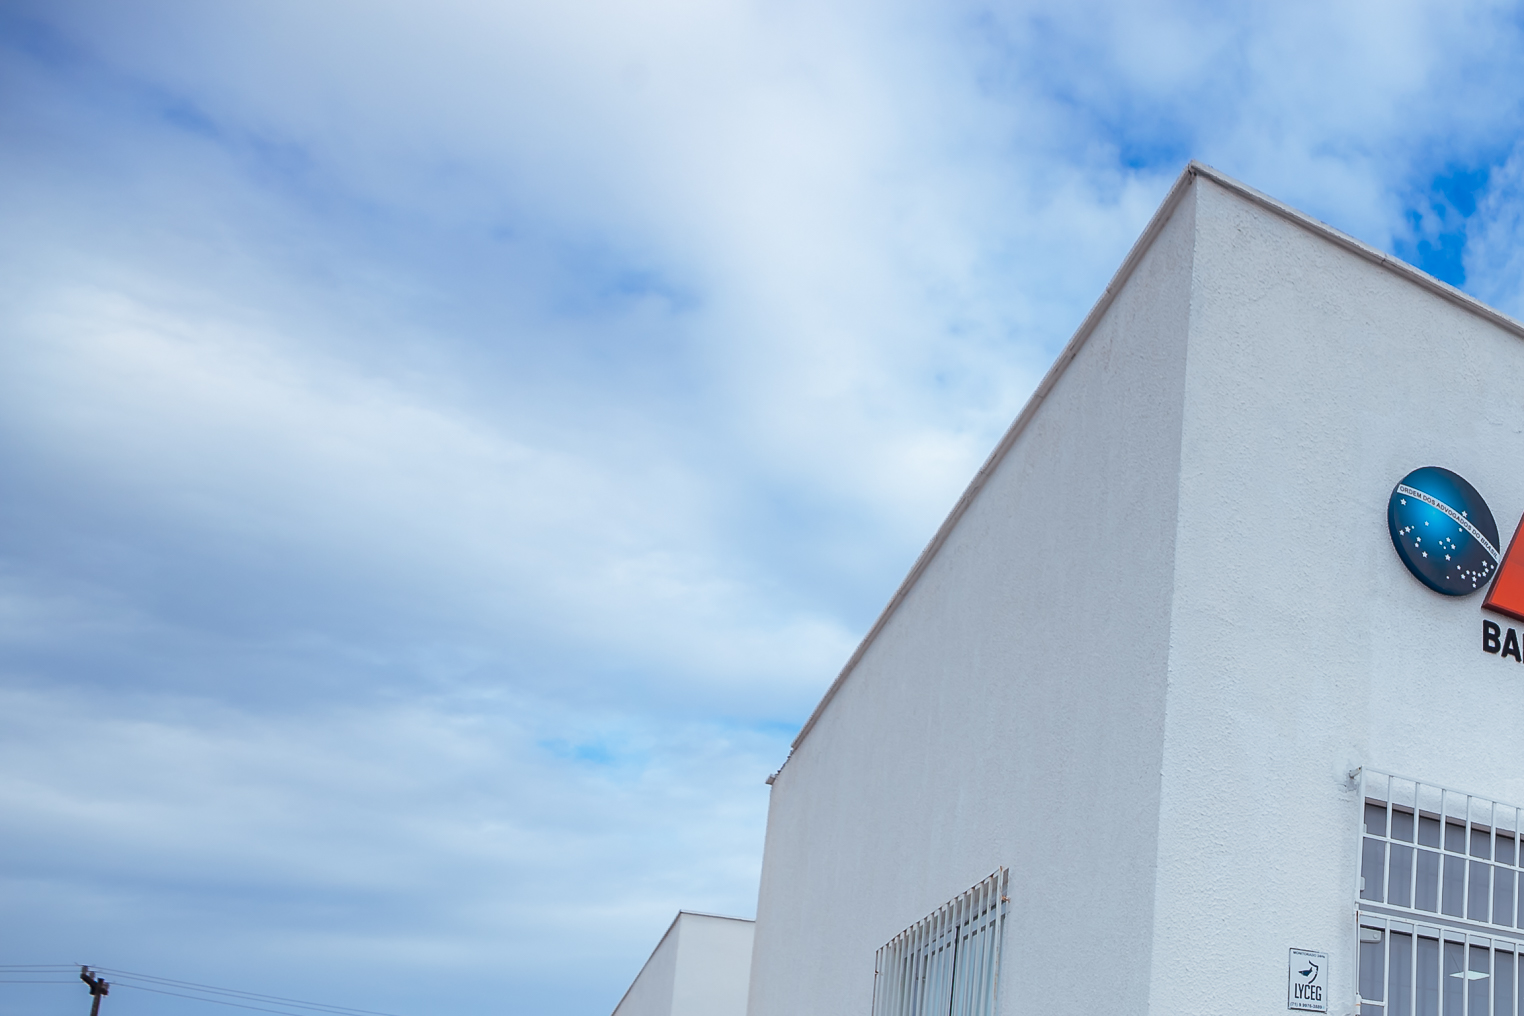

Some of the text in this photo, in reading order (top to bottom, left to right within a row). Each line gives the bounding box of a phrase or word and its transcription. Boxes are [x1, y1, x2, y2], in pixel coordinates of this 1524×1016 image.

[1400, 485, 1498, 559] ORDEM DOS ADVOGADOS DO BRASIL
[1294, 983, 1322, 1001] LYCEG
